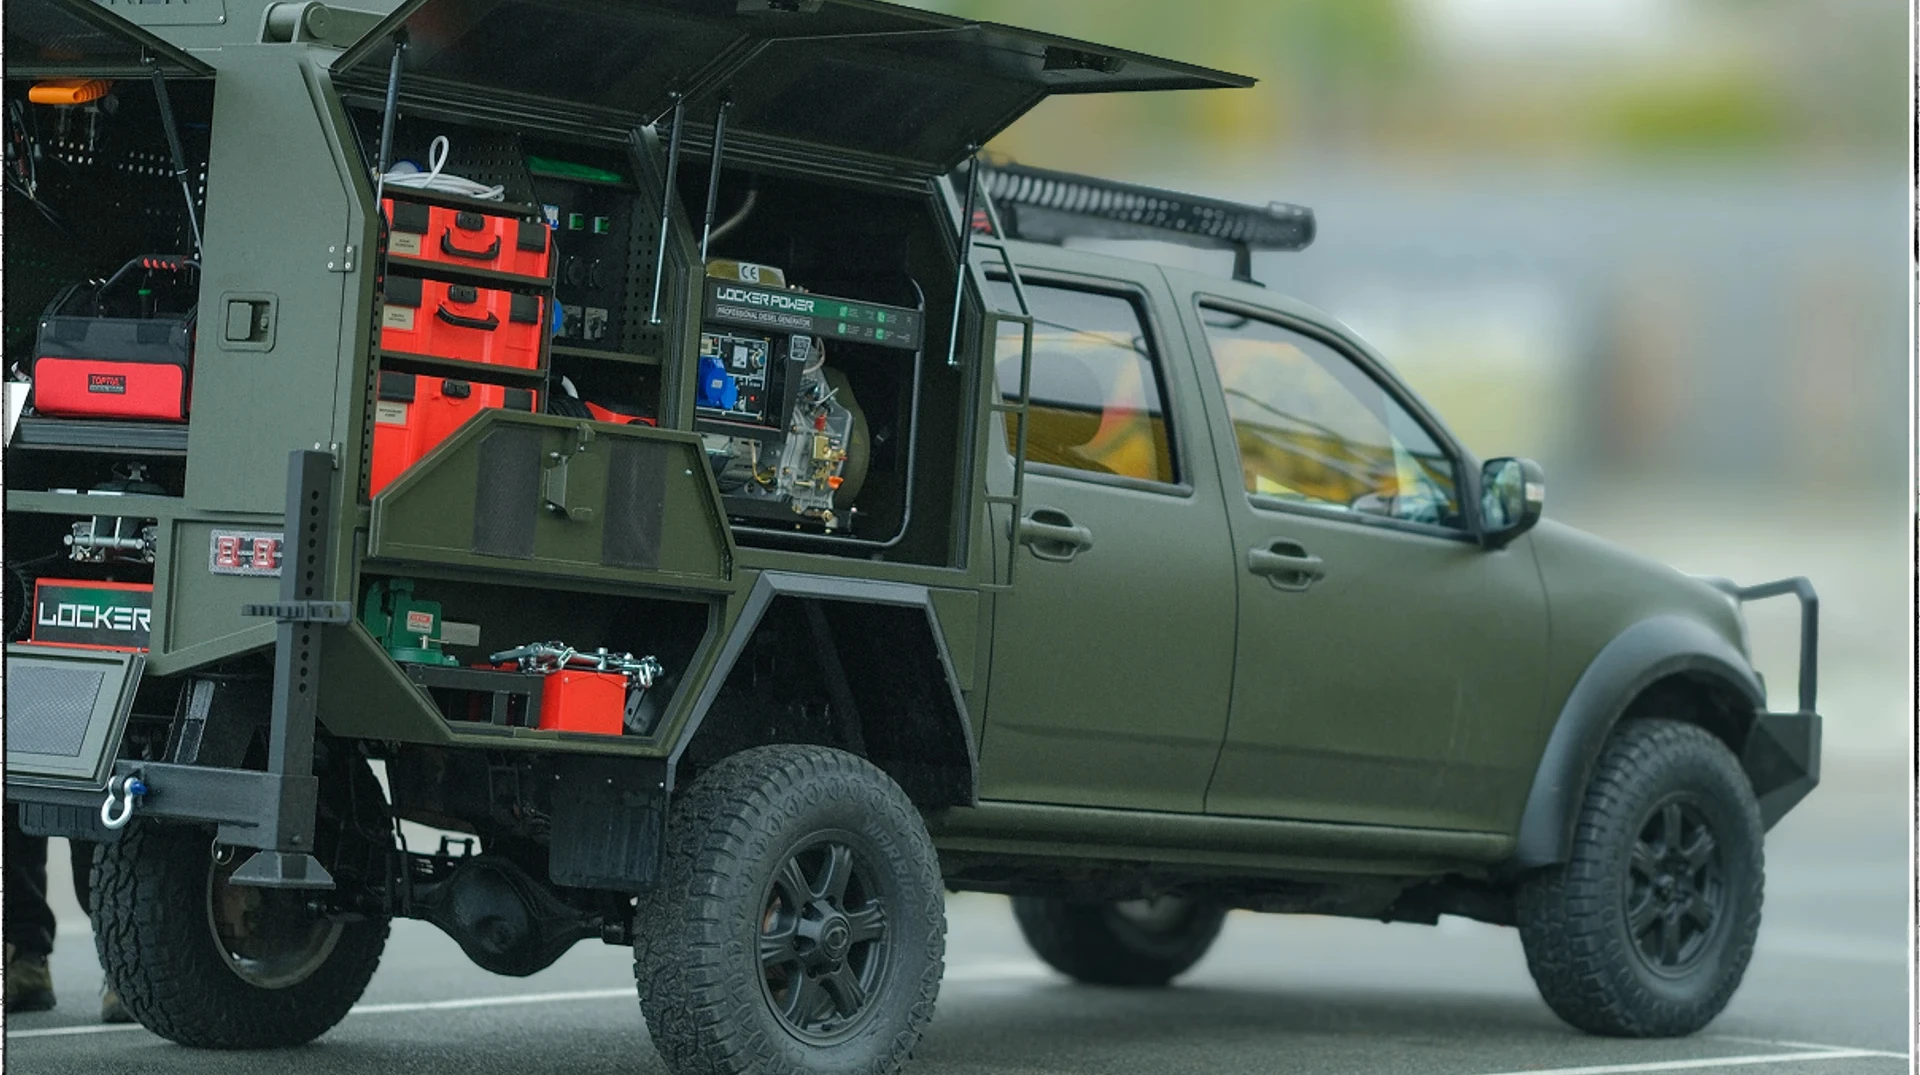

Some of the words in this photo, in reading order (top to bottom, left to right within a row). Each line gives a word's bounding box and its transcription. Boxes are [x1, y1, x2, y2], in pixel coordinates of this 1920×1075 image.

[741, 265, 757, 280] CE
[716, 287, 769, 306] LOCKER
[771, 295, 815, 313] POWER
[39, 602, 151, 632] LOCKER
